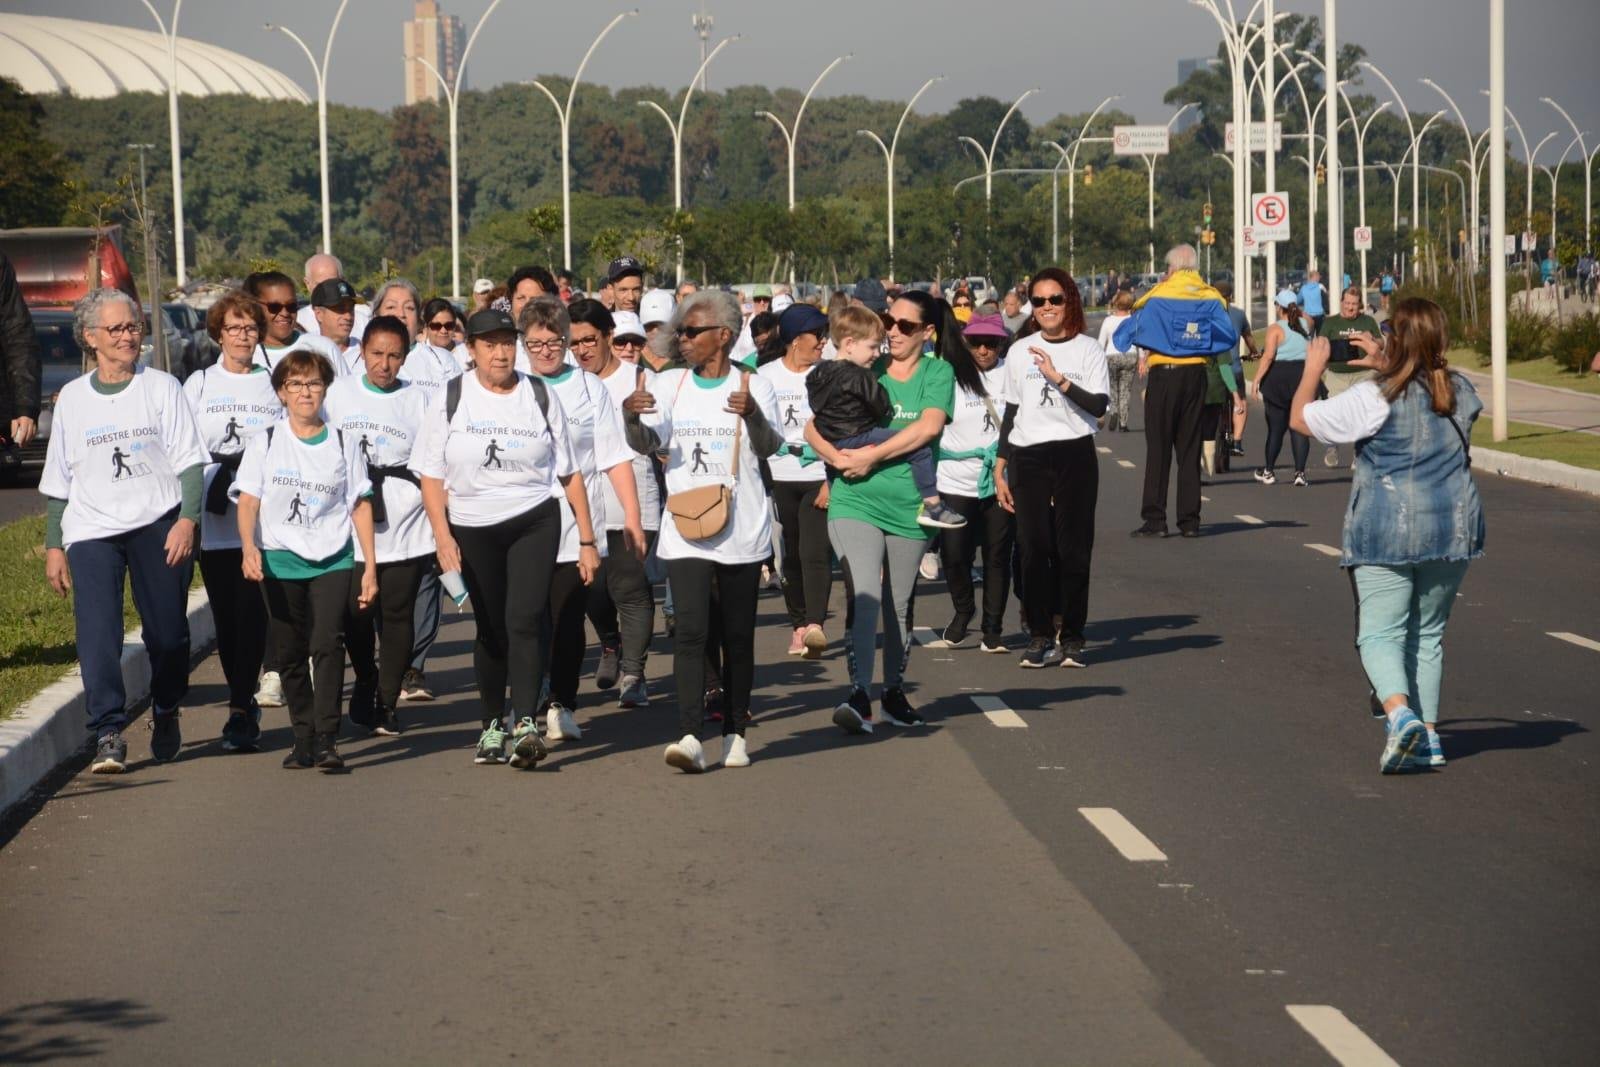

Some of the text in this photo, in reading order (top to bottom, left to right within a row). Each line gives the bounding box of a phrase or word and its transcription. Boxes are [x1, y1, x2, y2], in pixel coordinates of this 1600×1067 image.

[206, 403, 276, 416] PEDESTRE IDOSO
[341, 421, 407, 440] PEDESTRE IDOSO
[466, 425, 509, 435] PEDESTRE
[673, 427, 737, 437] PEDESTRE IDOS
[86, 429, 130, 447] PEDESTRE
